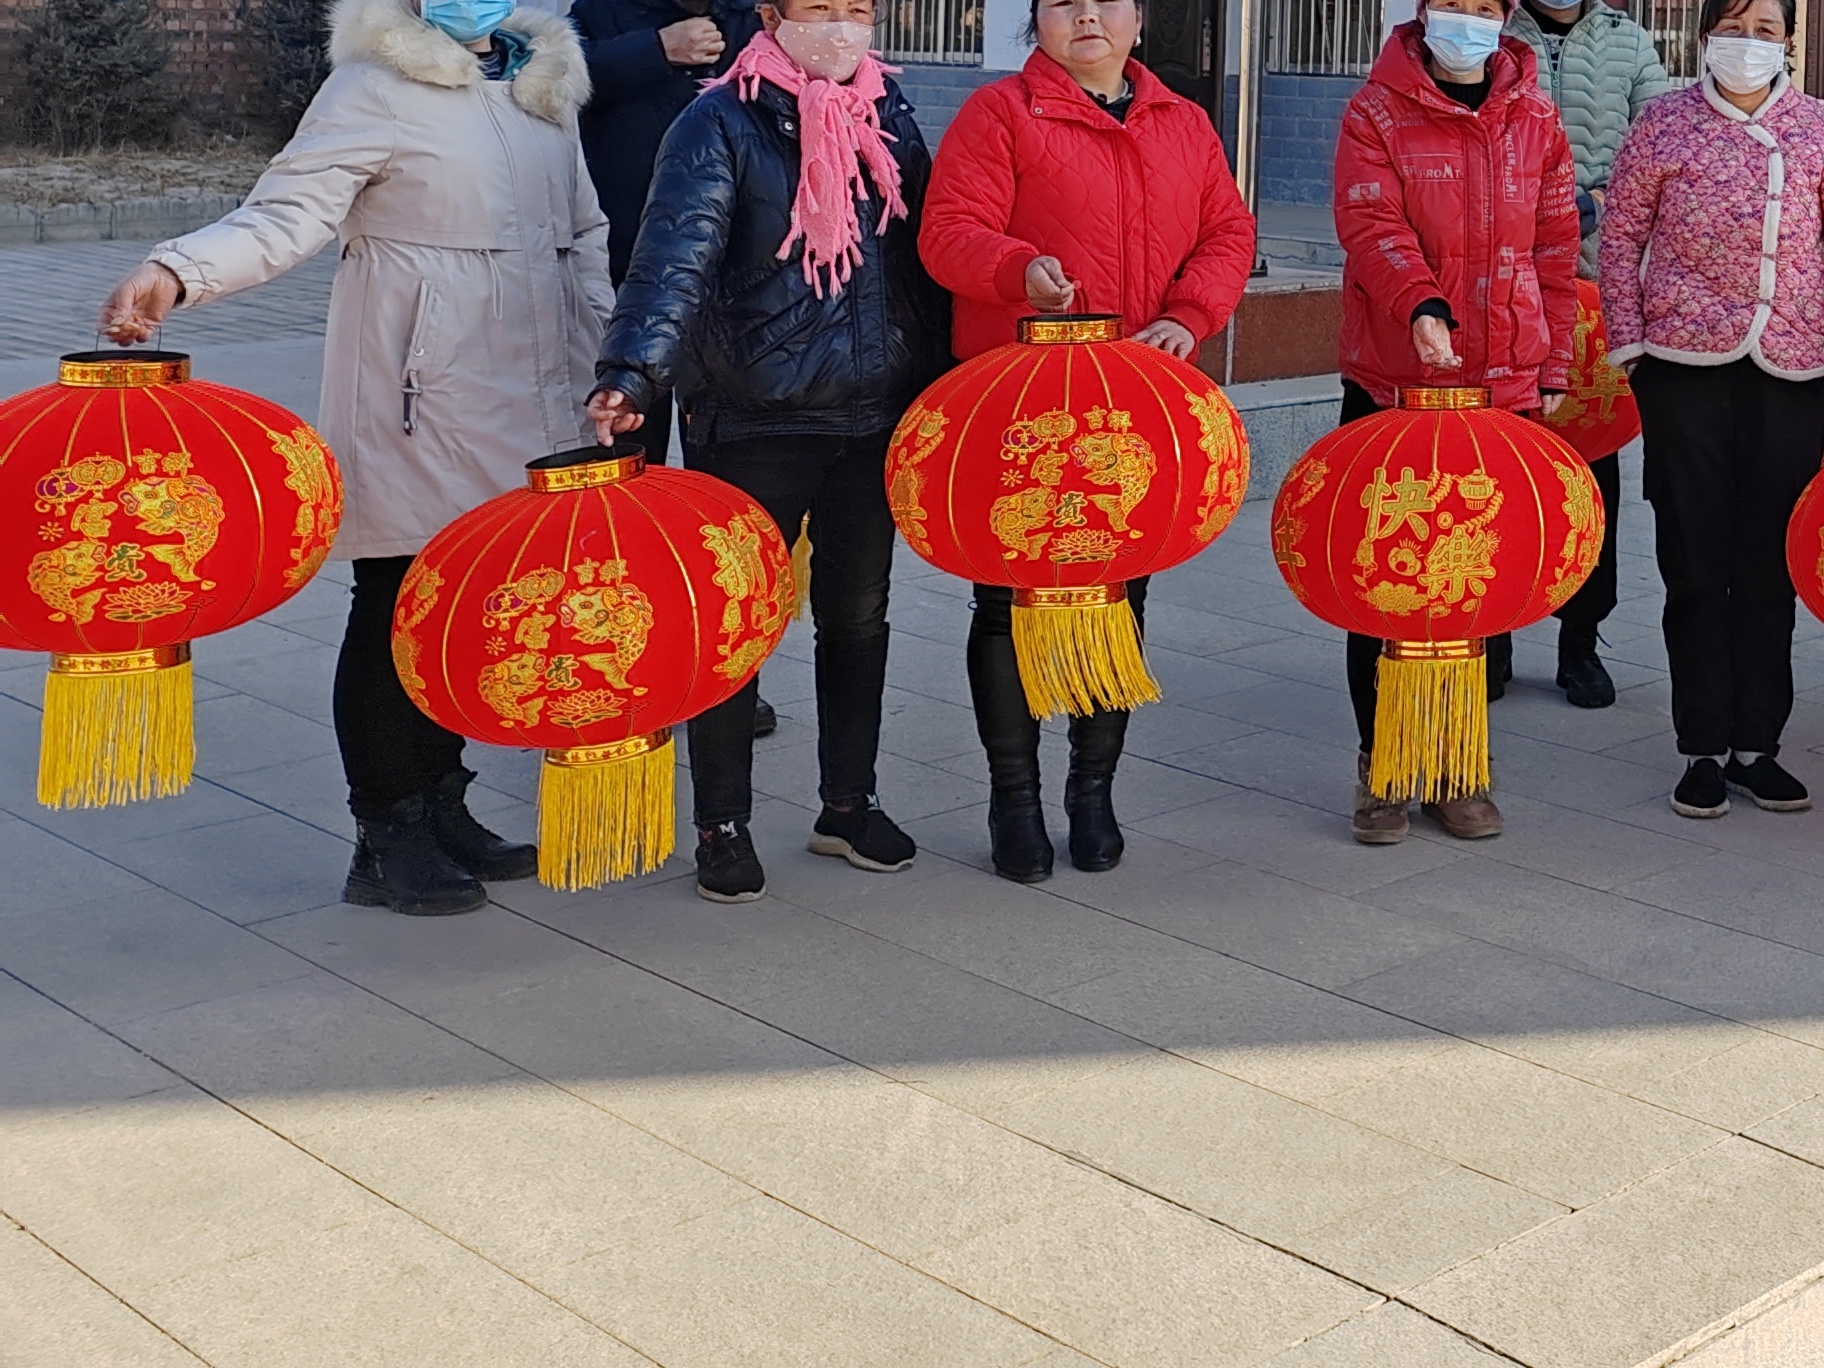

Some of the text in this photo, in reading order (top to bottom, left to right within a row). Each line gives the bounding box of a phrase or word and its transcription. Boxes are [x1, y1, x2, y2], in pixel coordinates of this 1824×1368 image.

[1083, 405, 1132, 432] 吉祥
[132, 448, 194, 476] 吉祥
[572, 557, 629, 584] 吉祥
